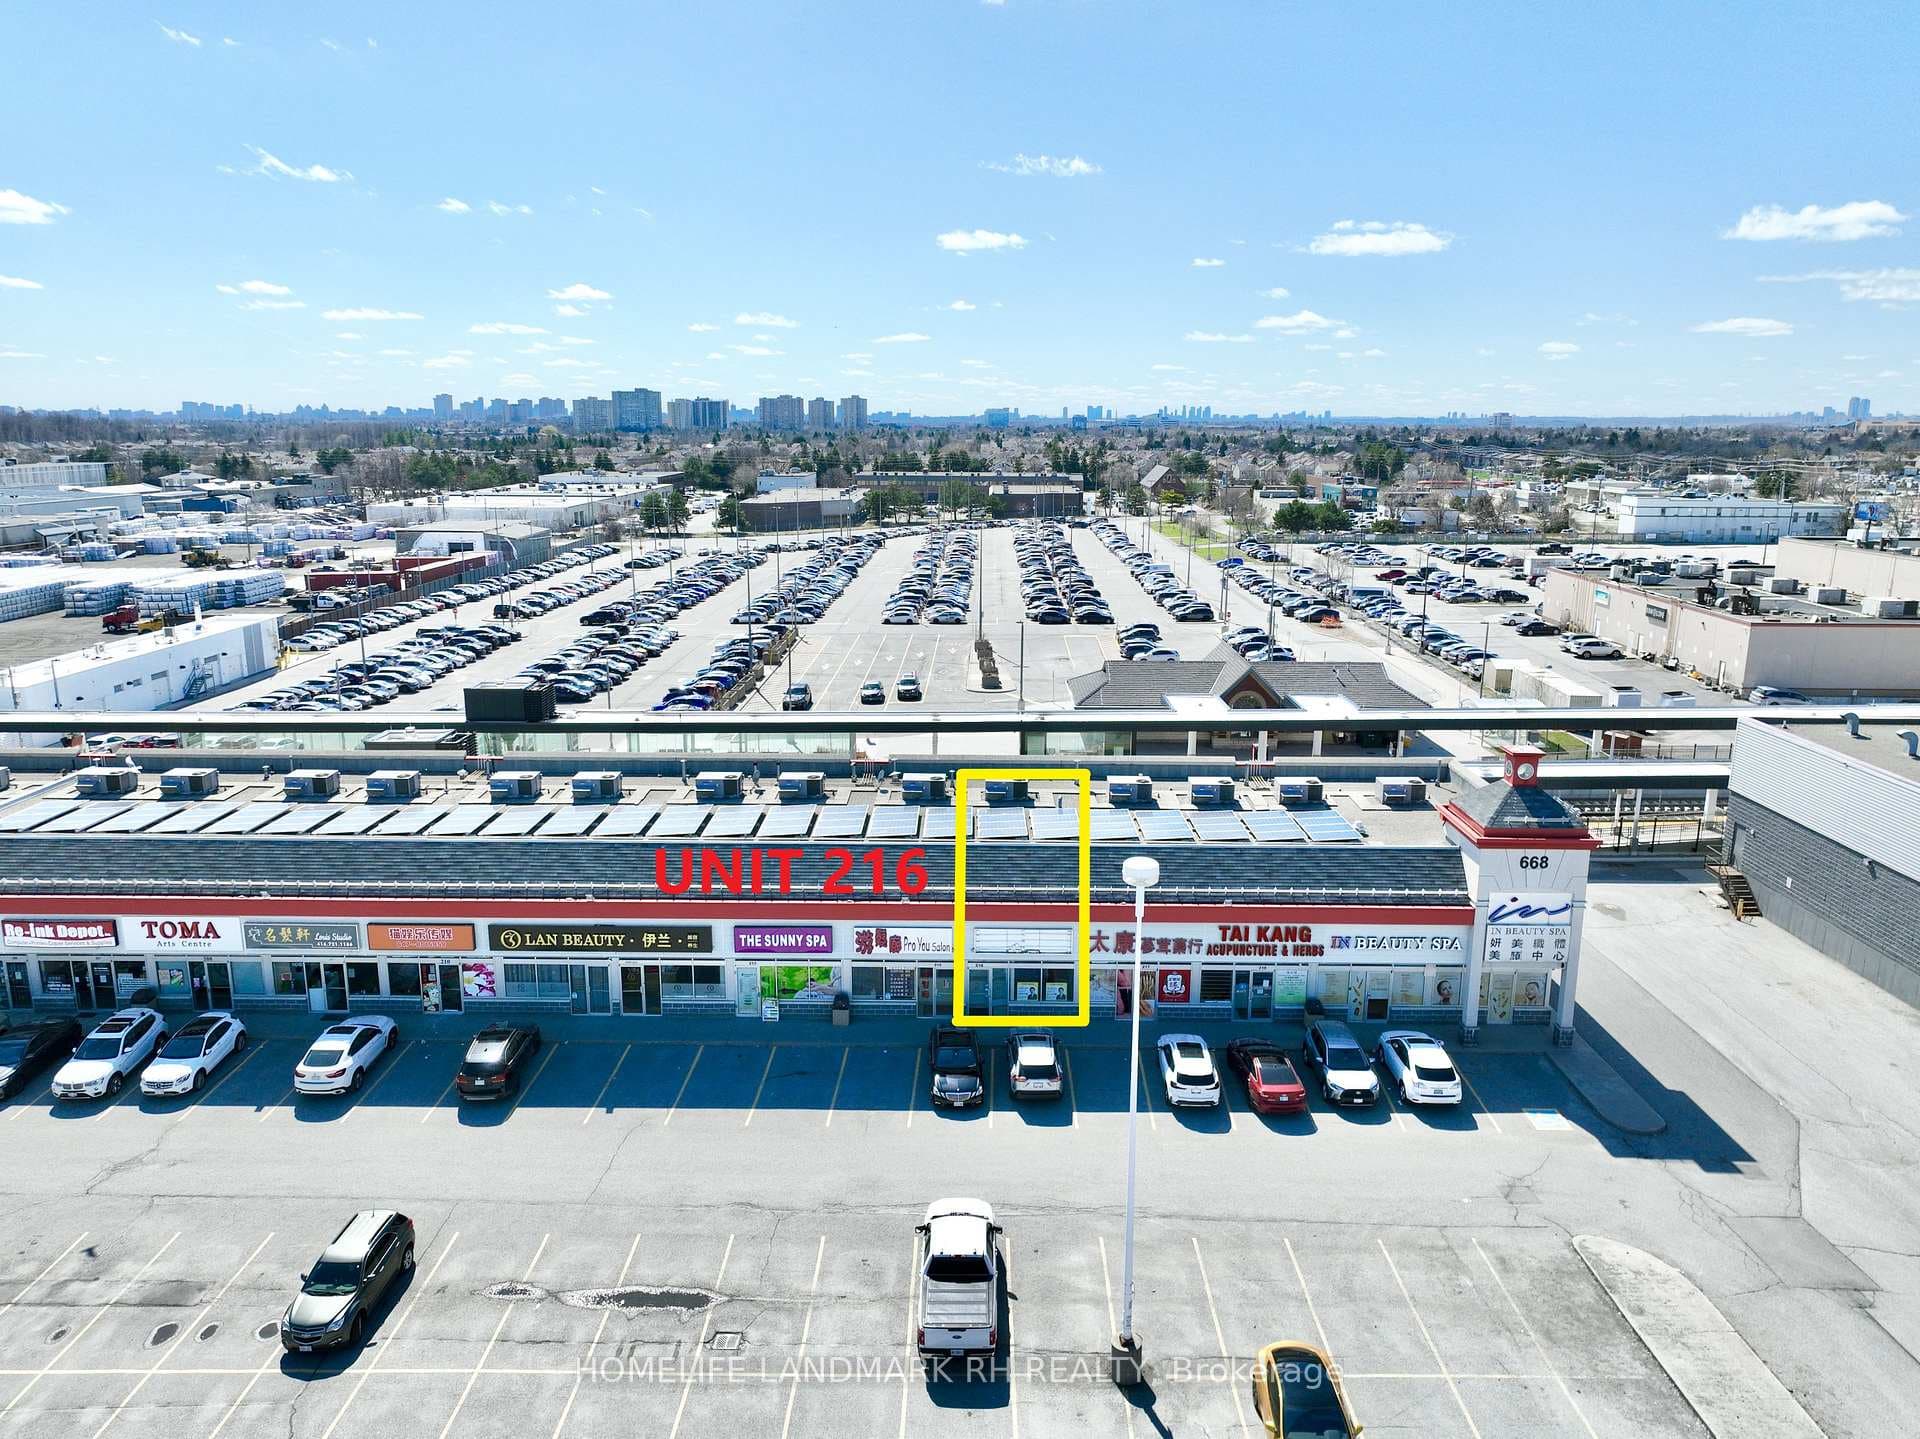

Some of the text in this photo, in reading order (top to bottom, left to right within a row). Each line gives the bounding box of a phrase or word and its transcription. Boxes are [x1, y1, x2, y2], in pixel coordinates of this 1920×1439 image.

[1519, 855, 1549, 870] 668
[4, 922, 56, 938] Re-ink
[140, 920, 221, 939] TOMA
[1218, 925, 1312, 943] TAI KANG
[1491, 927, 1567, 936] IN BEAUTY SPA
[524, 933, 626, 947] LAN BEAUTY
[739, 934, 828, 947] THE SUNNY SPA
[903, 936, 951, 953] Pro You Salon
[1331, 936, 1463, 951] IN BEAUTY SPA
[1206, 944, 1325, 957] ACUPUNCTURE & HERBS
